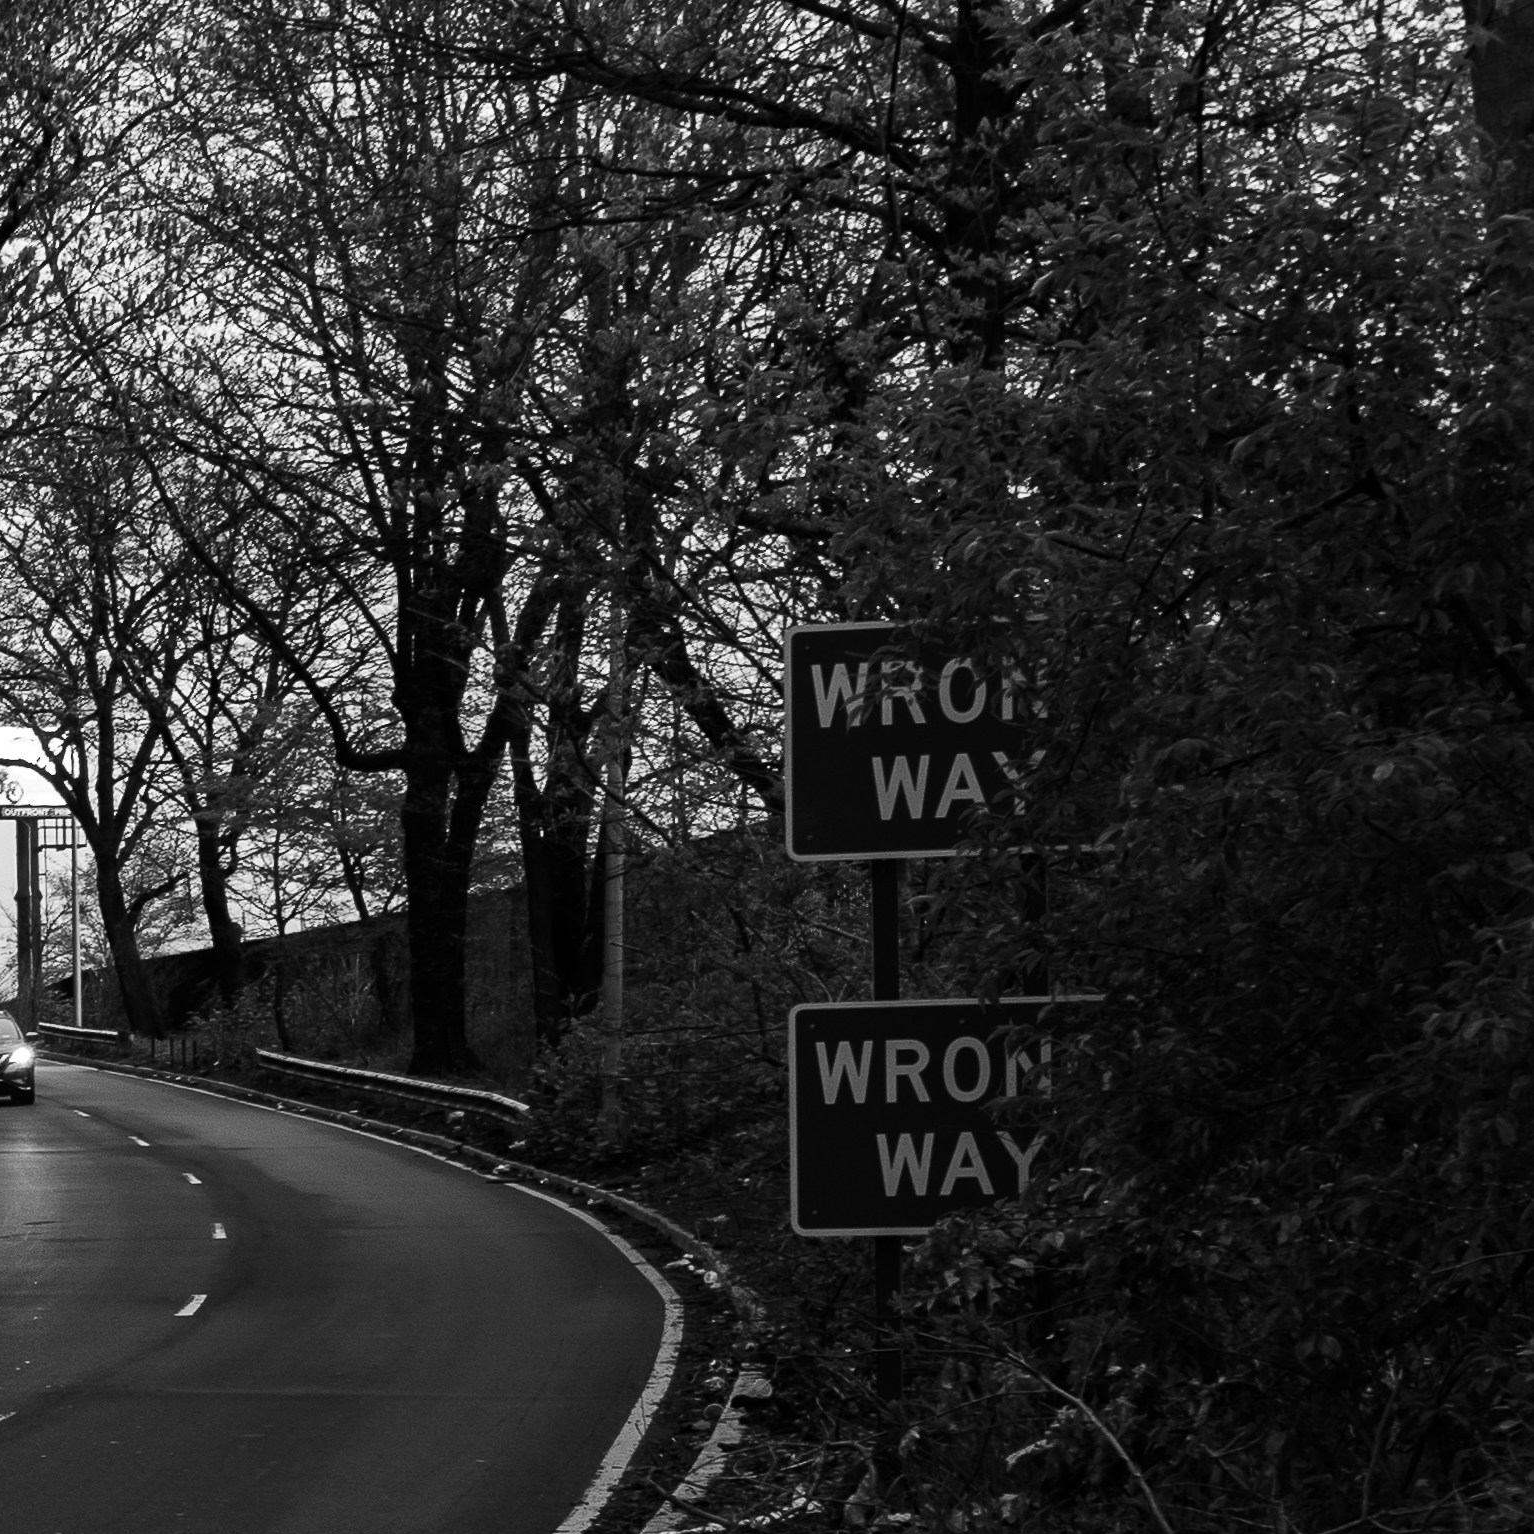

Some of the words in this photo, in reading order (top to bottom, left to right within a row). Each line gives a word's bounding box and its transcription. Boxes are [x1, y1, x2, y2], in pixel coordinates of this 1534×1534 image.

[872, 749, 1047, 820] WAY
[816, 1036, 1052, 1105] WRON
[876, 1131, 1048, 1197] WAY
